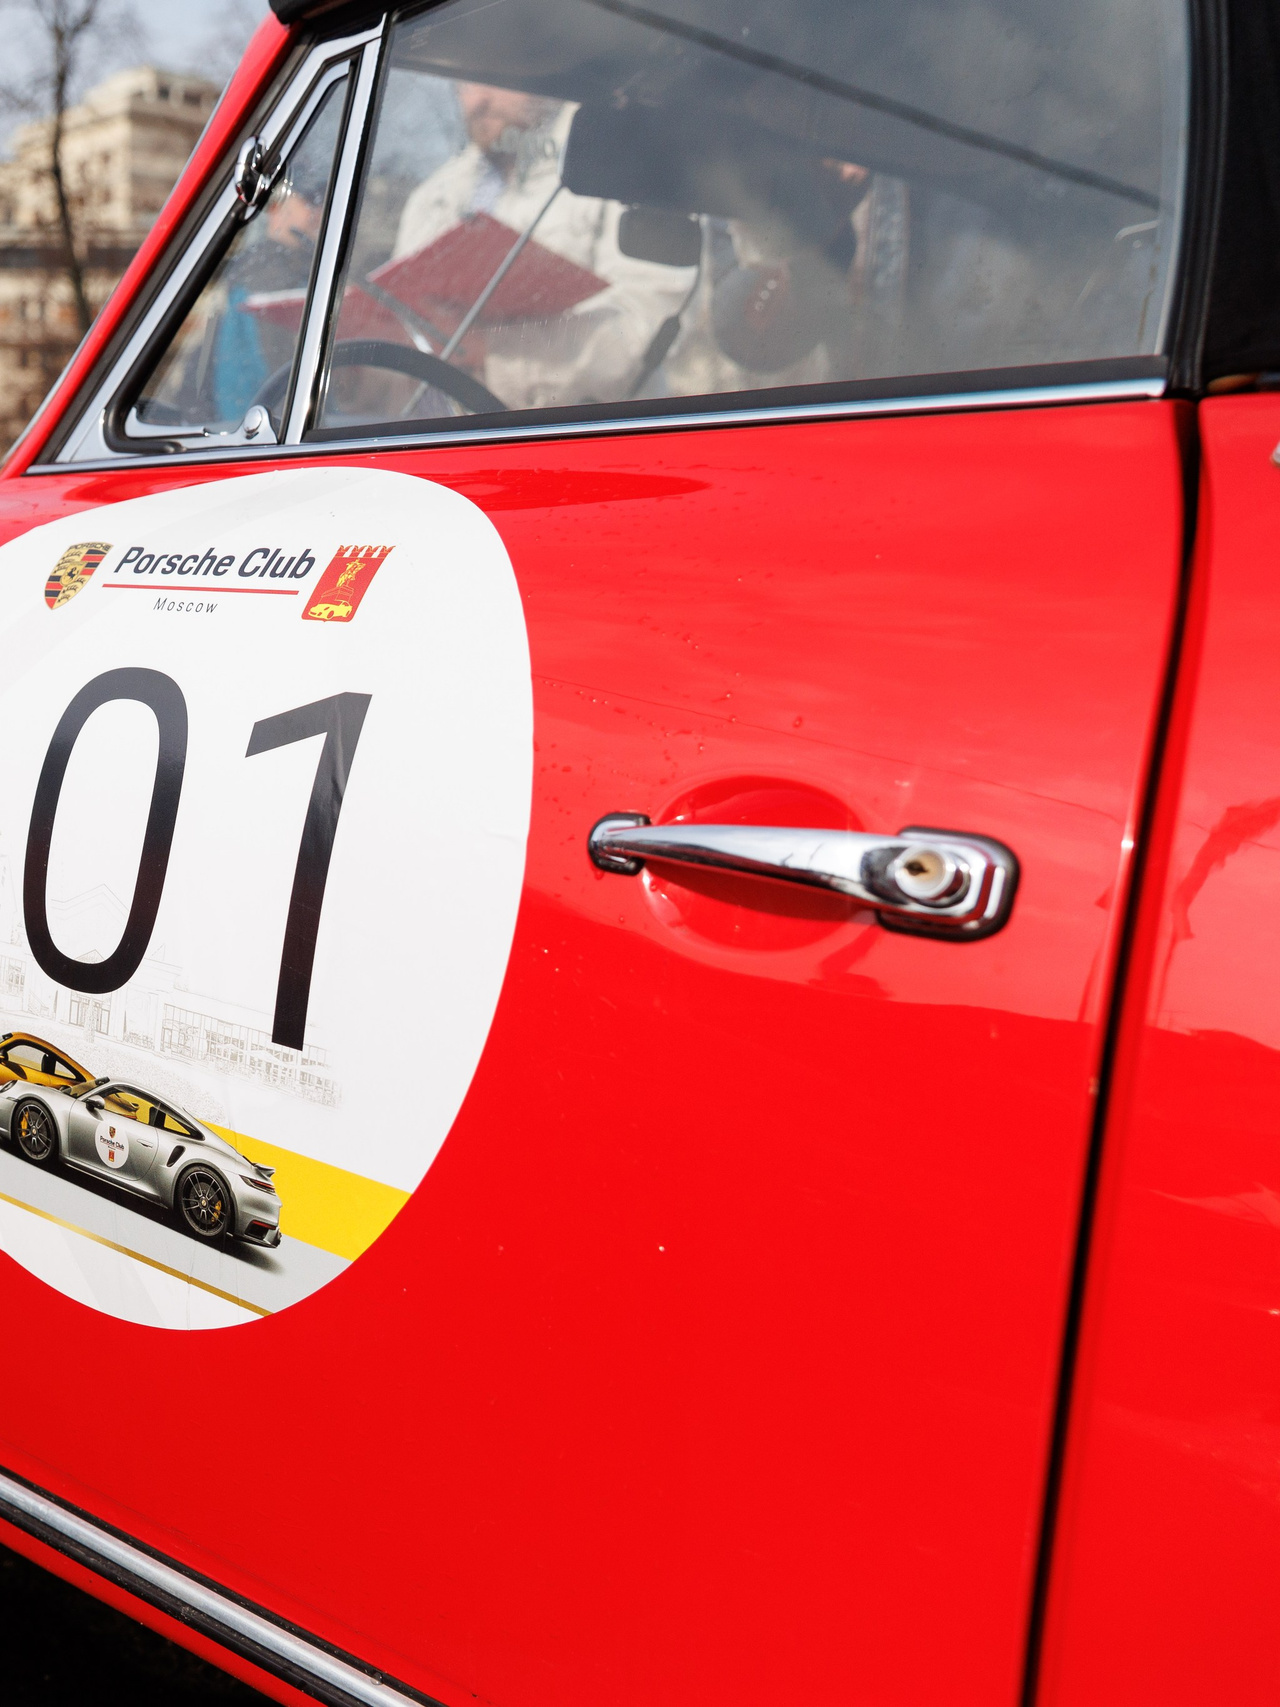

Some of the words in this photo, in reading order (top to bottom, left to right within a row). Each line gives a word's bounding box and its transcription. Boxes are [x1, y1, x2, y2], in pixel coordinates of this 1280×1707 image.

[114, 547, 236, 577] Porsche
[238, 548, 316, 579] Club
[153, 598, 218, 613] Moscow
[23, 667, 373, 1051] 01
